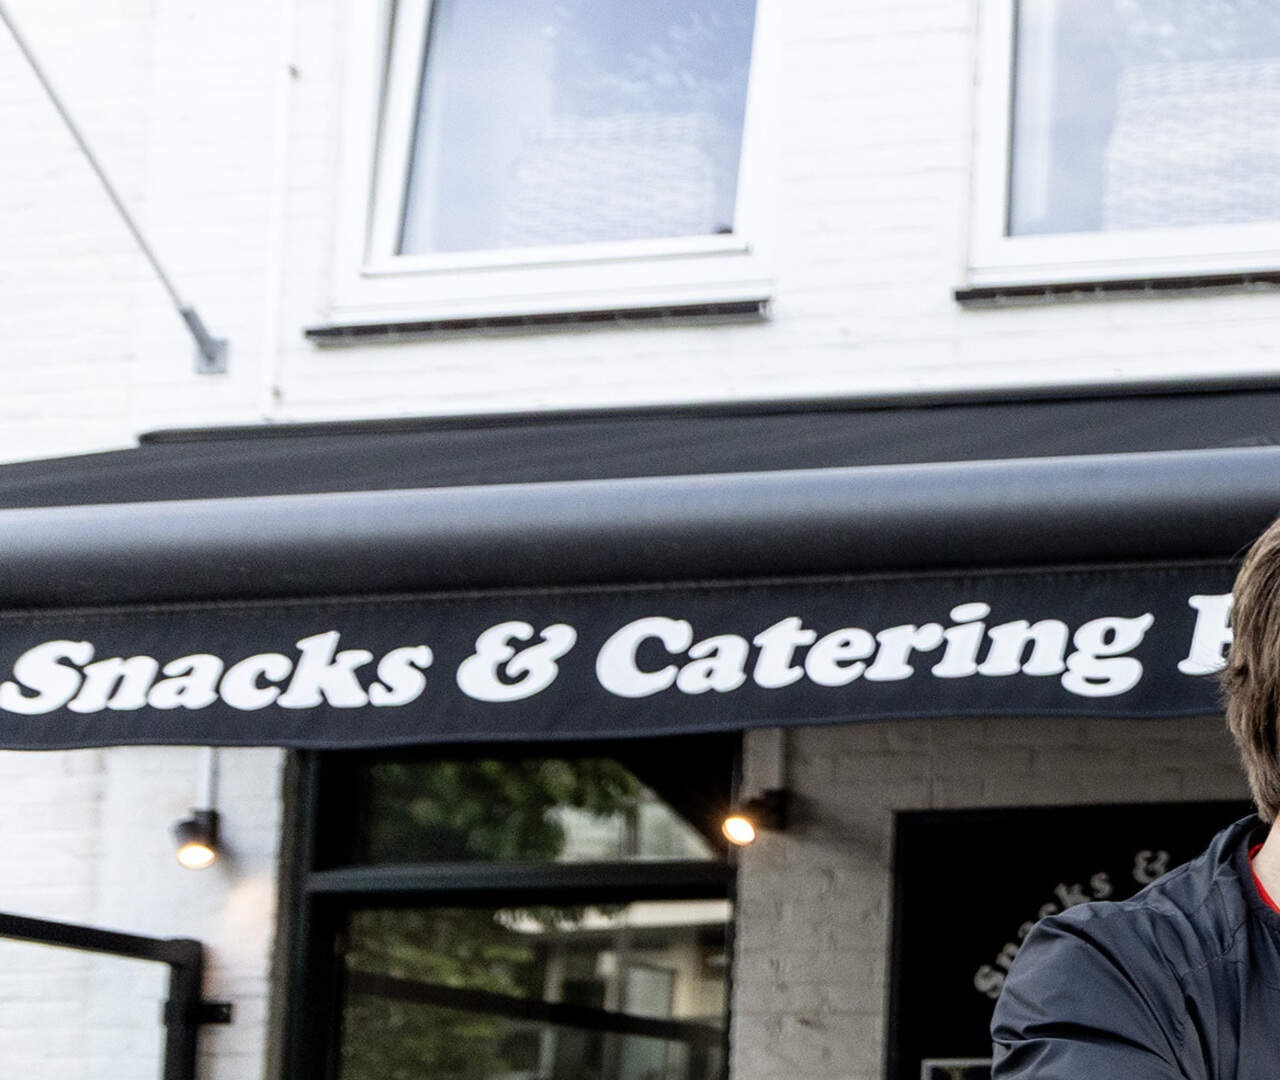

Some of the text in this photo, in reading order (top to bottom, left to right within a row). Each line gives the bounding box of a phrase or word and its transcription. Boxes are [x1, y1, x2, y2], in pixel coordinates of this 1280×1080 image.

[0, 629, 434, 715] Snacks
[456, 620, 578, 702] &
[595, 602, 1154, 698] Catering
